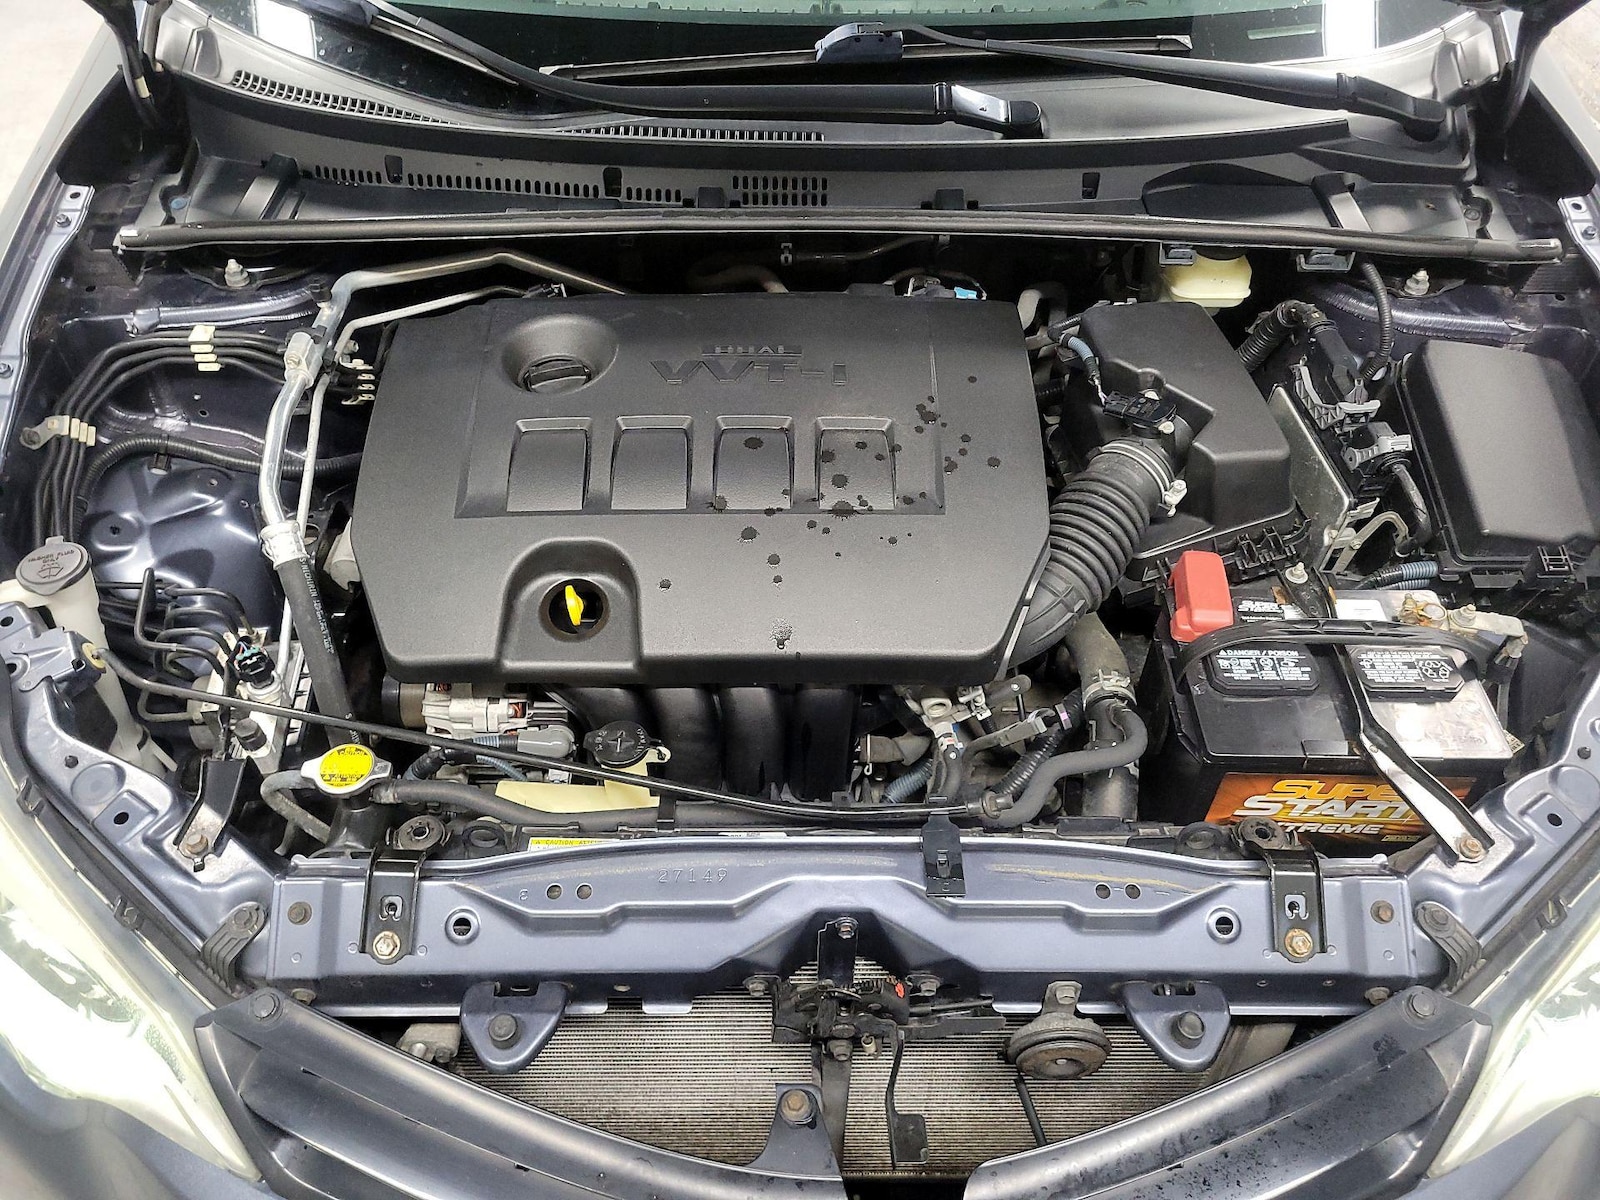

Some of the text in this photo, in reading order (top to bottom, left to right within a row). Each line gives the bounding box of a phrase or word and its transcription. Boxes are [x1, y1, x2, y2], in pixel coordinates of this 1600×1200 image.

[1267, 649, 1299, 657] POISON
[1265, 779, 1402, 802] SUPE
[1233, 795, 1410, 819] START
[1277, 821, 1385, 835] TREME
[657, 867, 729, 884] 27149
